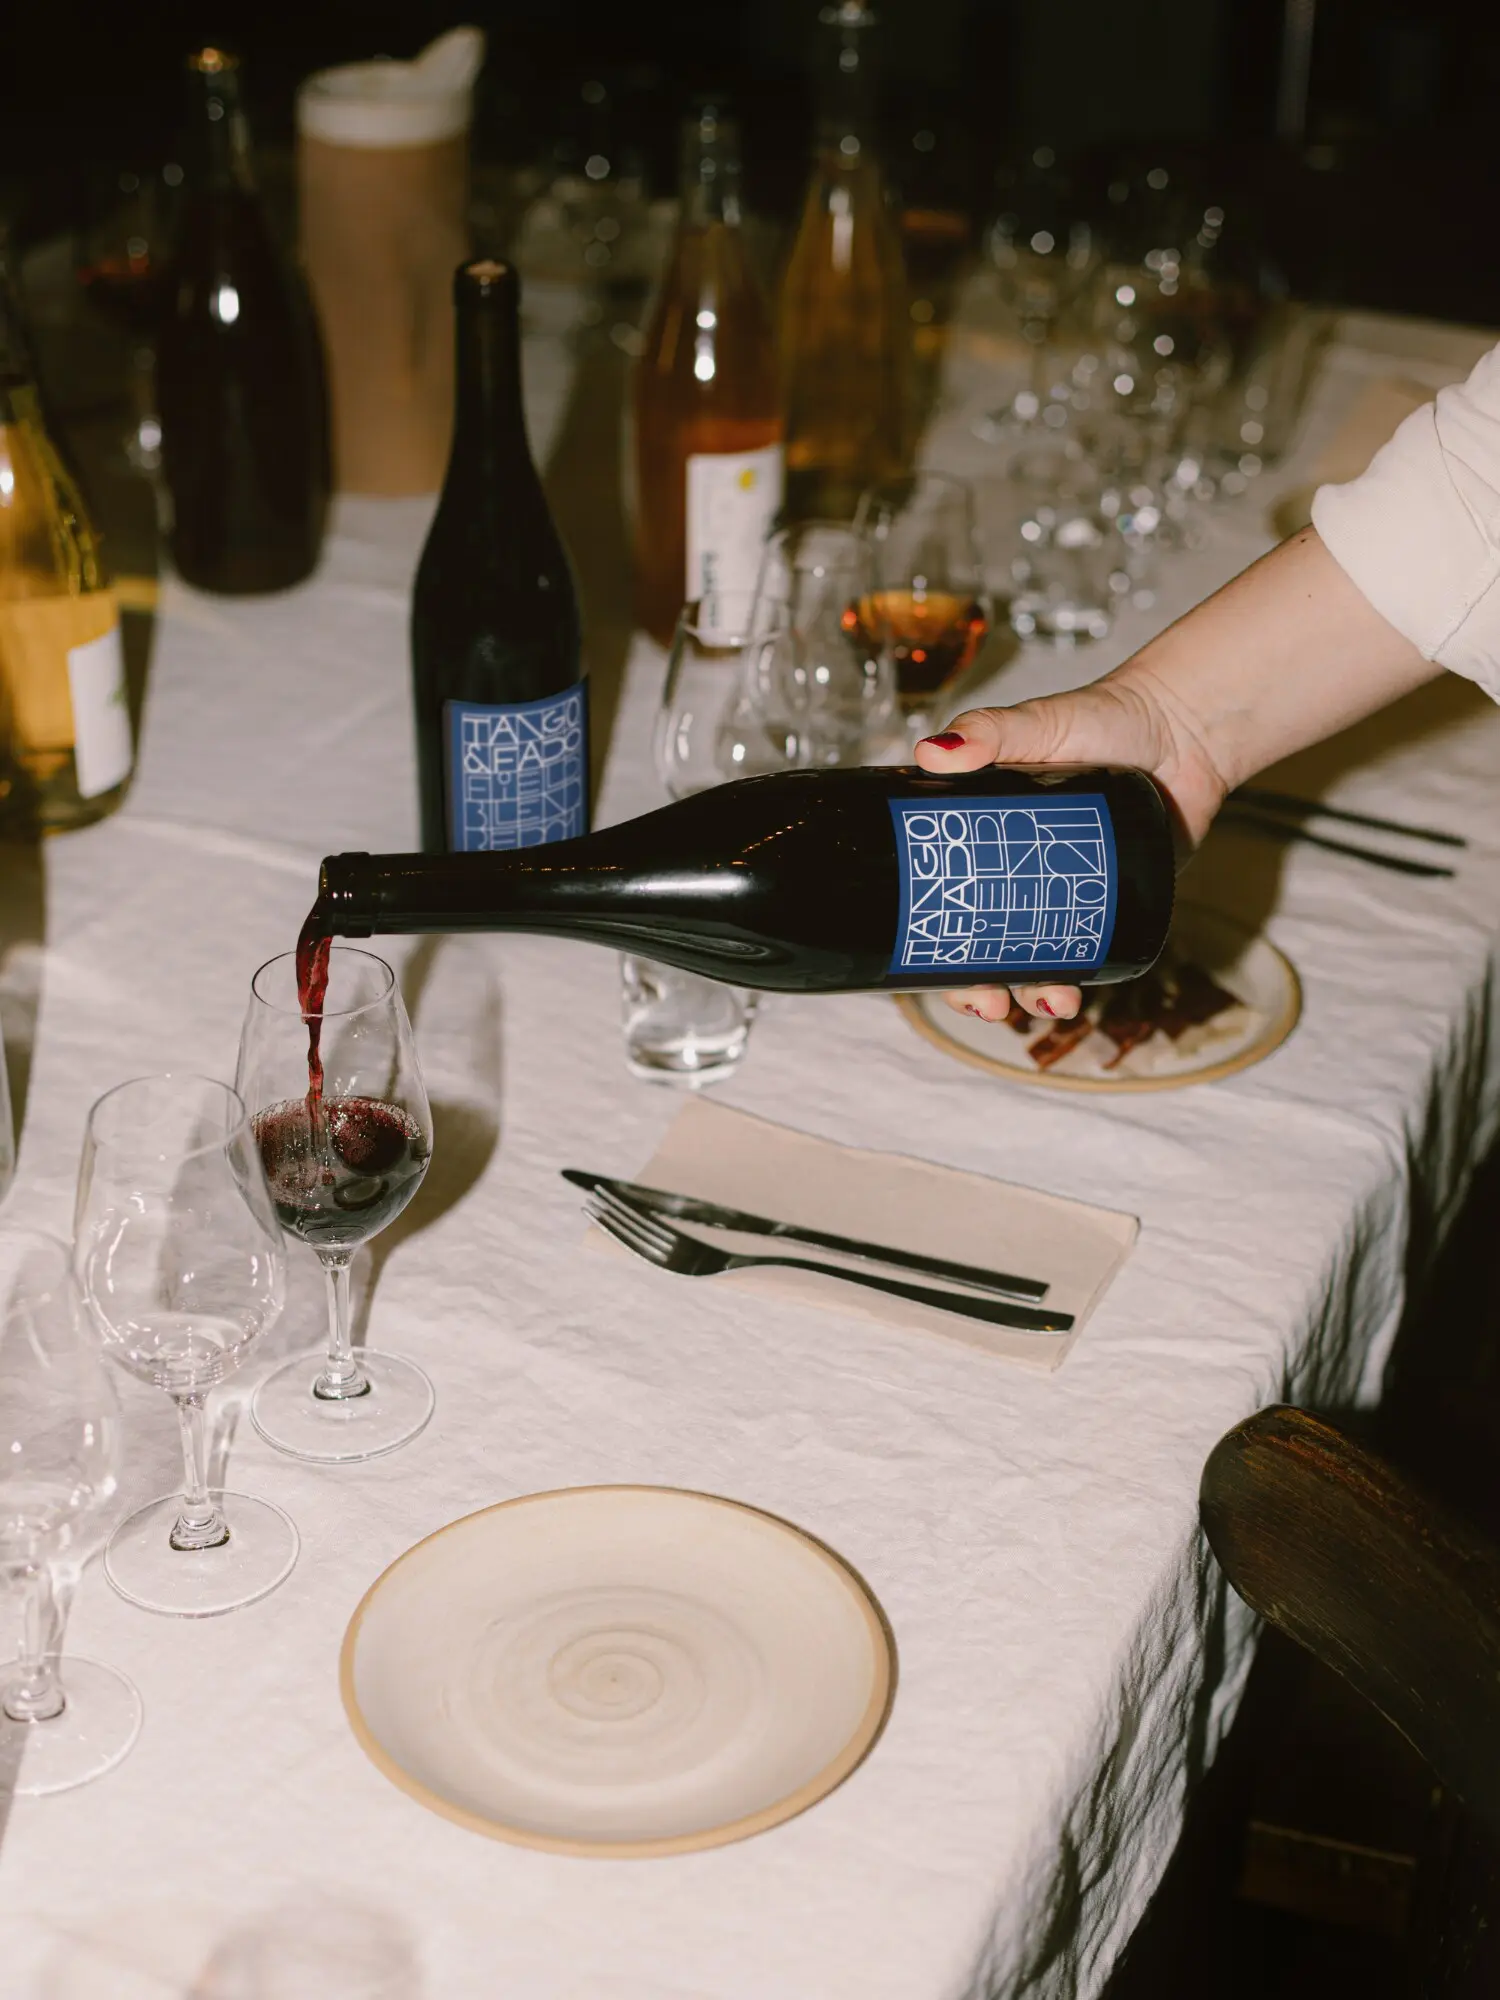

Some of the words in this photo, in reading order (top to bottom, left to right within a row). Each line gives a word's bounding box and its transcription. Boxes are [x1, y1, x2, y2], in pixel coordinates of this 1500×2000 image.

[462, 696, 580, 744] TANGO
[464, 743, 491, 774] &
[494, 728, 581, 774] FADO
[465, 779, 581, 825] BLEND
[906, 813, 943, 965] TANGO
[941, 812, 976, 937] FADO
[1001, 810, 1042, 961] BLEND
[934, 940, 969, 963] &
[1034, 875, 1074, 961] RED
